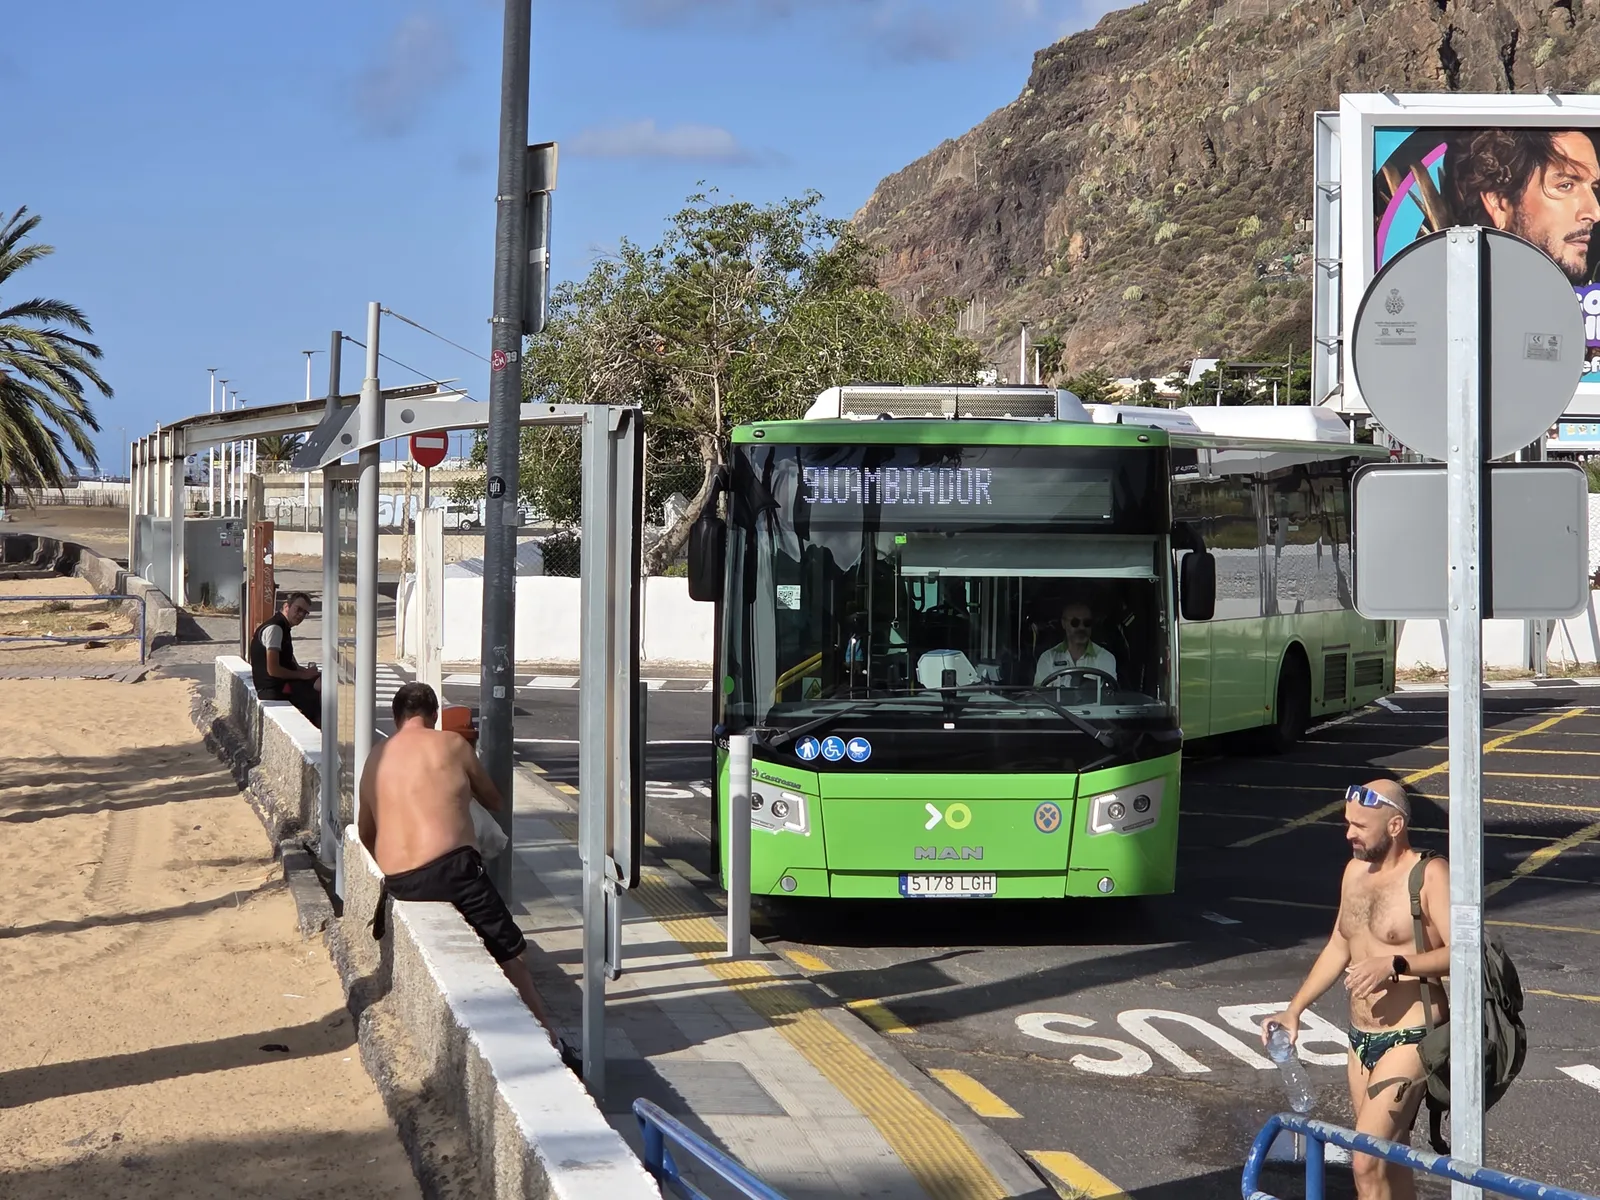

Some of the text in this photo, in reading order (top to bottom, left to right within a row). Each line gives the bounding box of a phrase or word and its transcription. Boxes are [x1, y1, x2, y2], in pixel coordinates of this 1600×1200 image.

[914, 846, 984, 860] MAN
[912, 876, 992, 891] 5178 LGH
[1015, 1001, 1350, 1077] BUS
